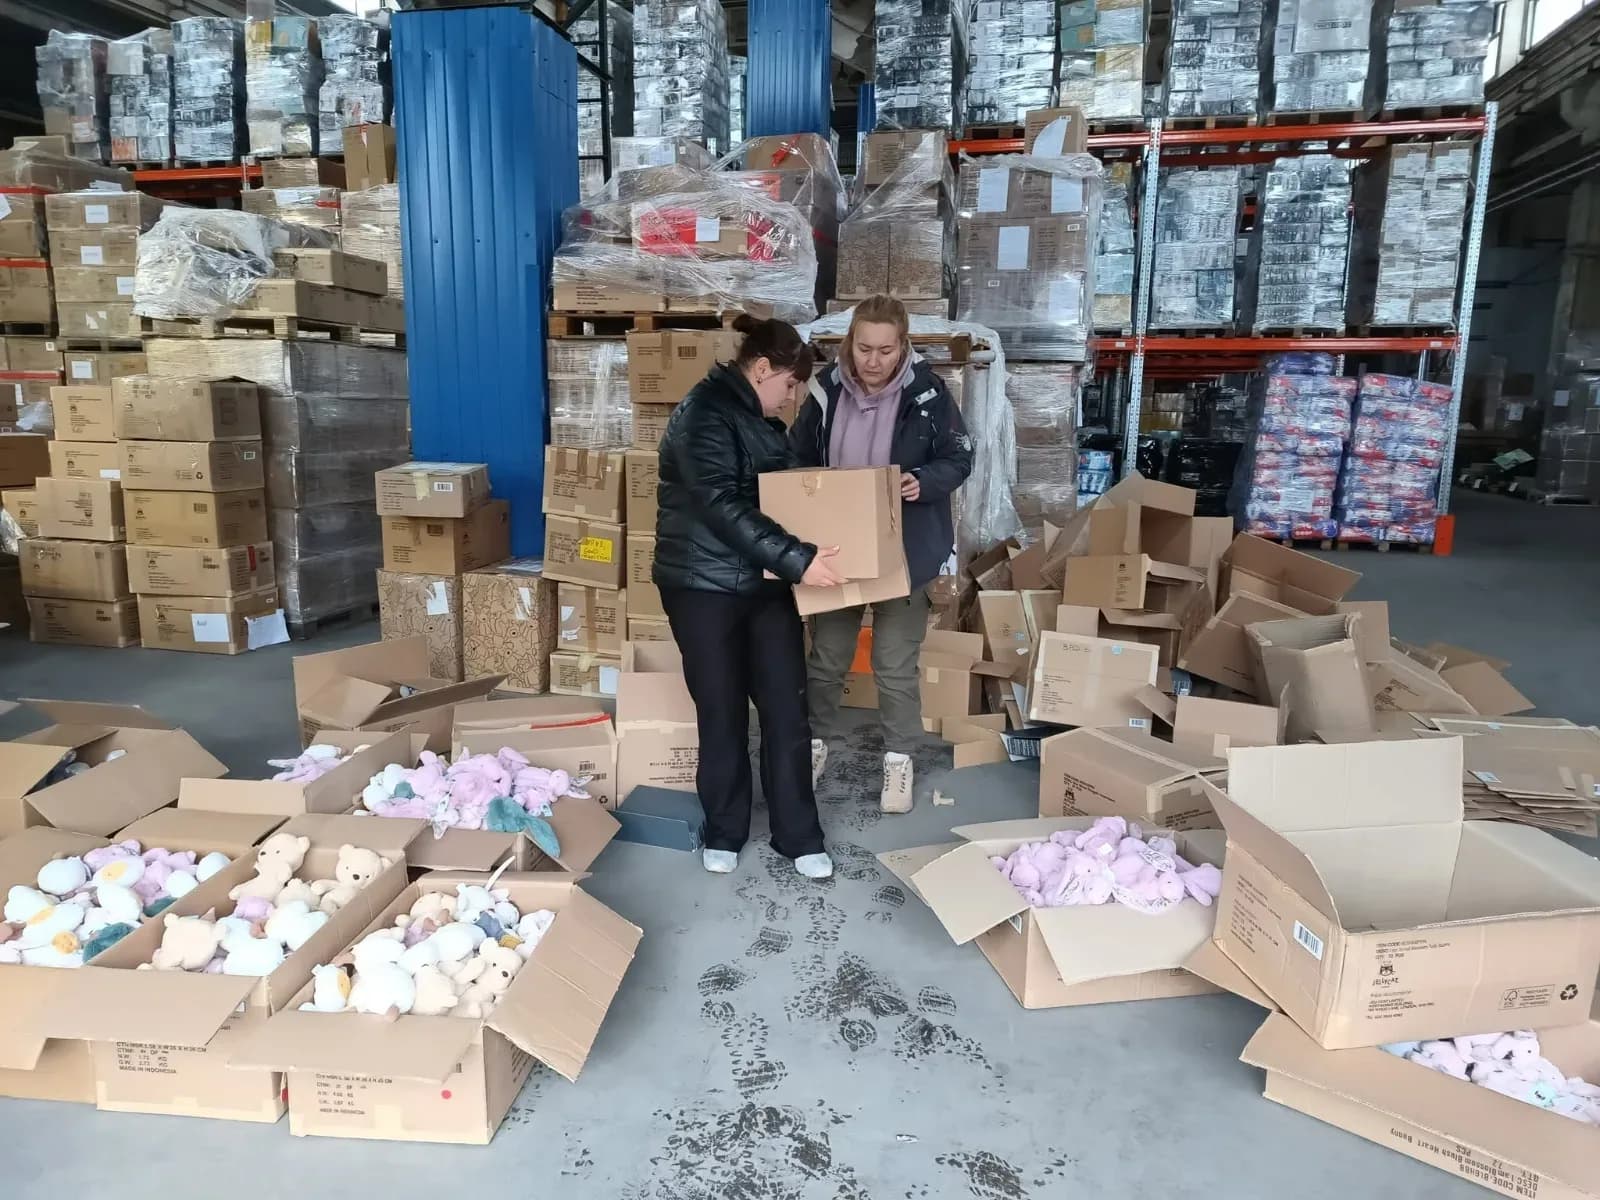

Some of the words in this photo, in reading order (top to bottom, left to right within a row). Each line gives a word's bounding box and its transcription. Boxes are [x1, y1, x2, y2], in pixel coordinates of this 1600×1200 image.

[1390, 1127, 1413, 1143] Bunny
[1417, 1139, 1440, 1154] Heart
[1455, 1144, 1472, 1157] PCS
[1441, 1148, 1463, 1163] Blush
[1516, 1185, 1536, 1200] ITEM
